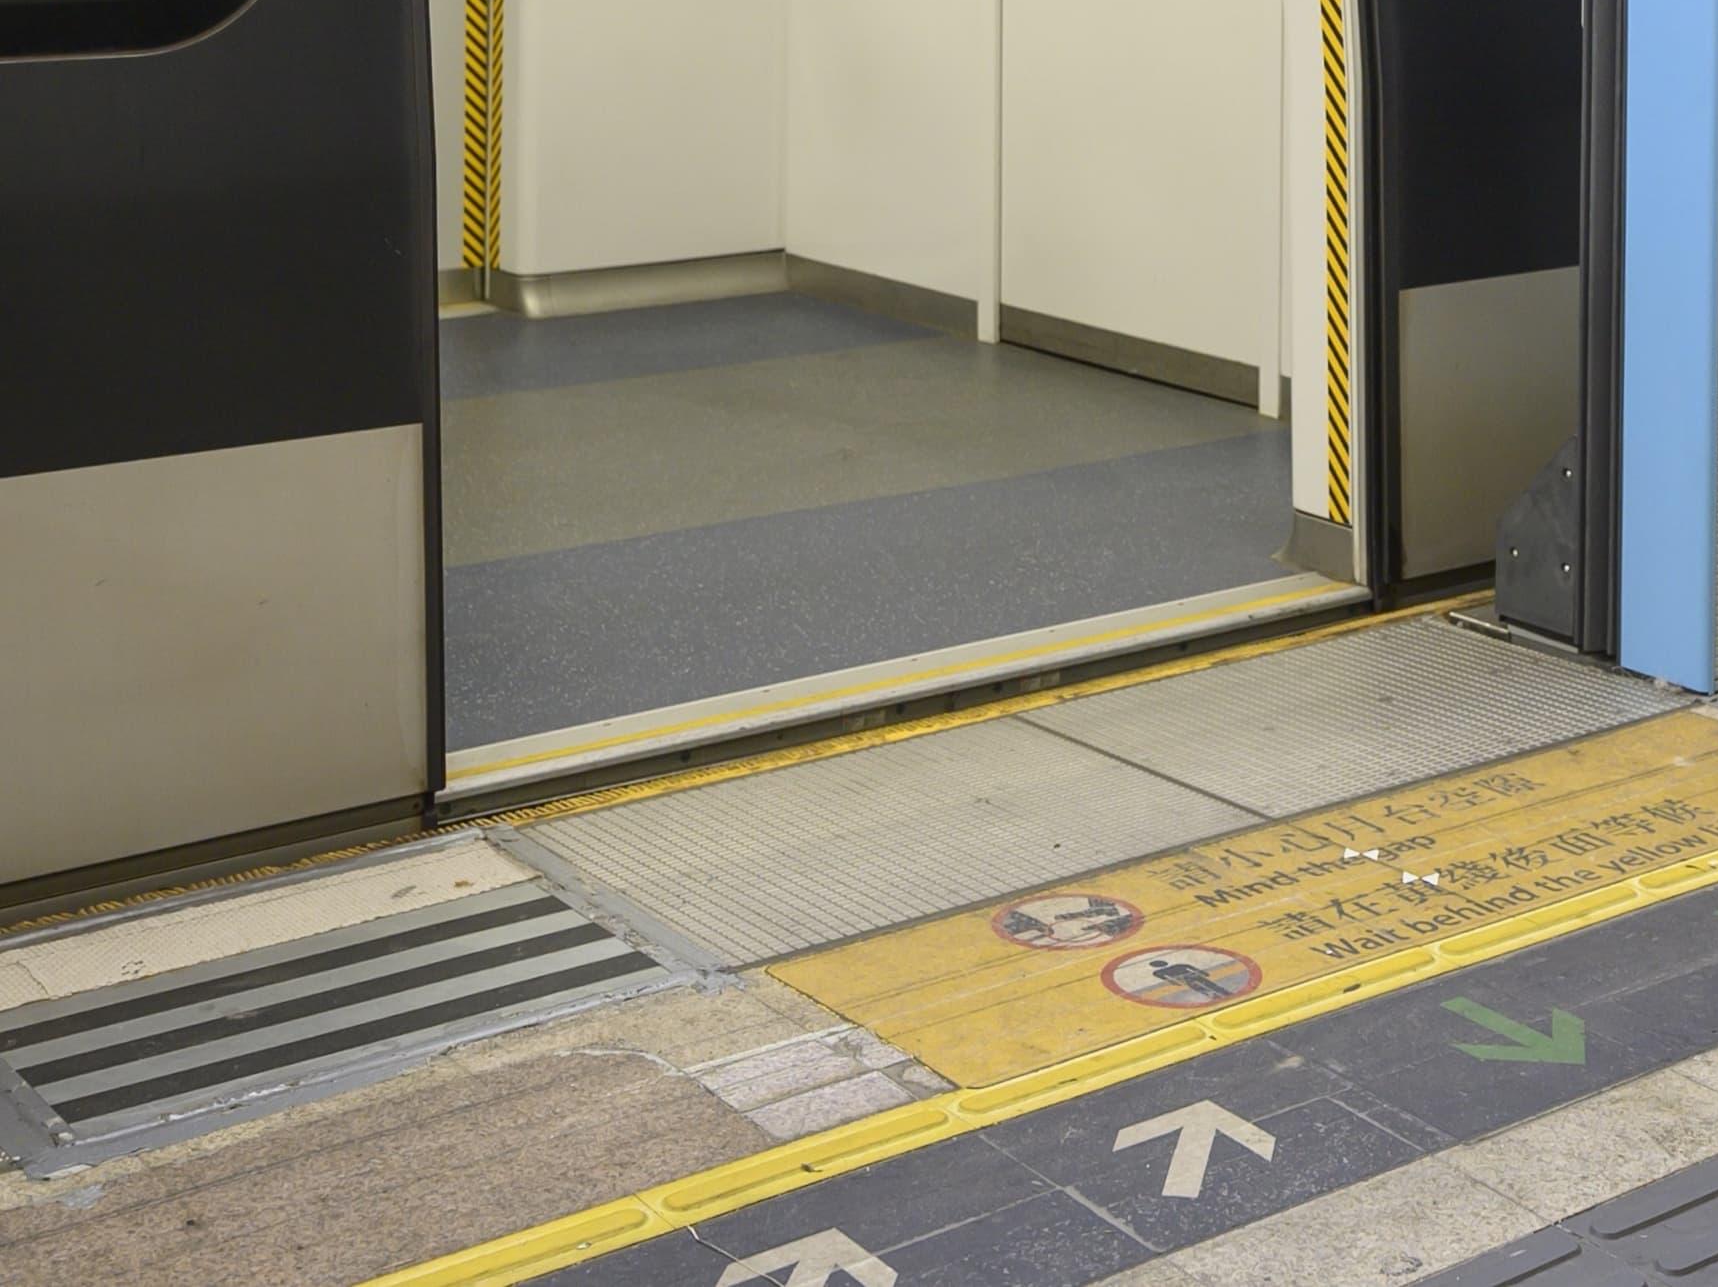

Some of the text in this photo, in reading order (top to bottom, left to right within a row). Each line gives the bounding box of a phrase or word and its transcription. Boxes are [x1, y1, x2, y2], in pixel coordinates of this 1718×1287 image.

[1148, 771, 1546, 892] 請小心月台空隙
[1194, 834, 1437, 908] Mind the gap
[1257, 799, 1714, 941] 請在黃綫後面等候
[1311, 921, 1411, 961] Wait
[1408, 878, 1539, 936] behind
[1535, 866, 1600, 895] the
[1597, 834, 1705, 877] yellow
